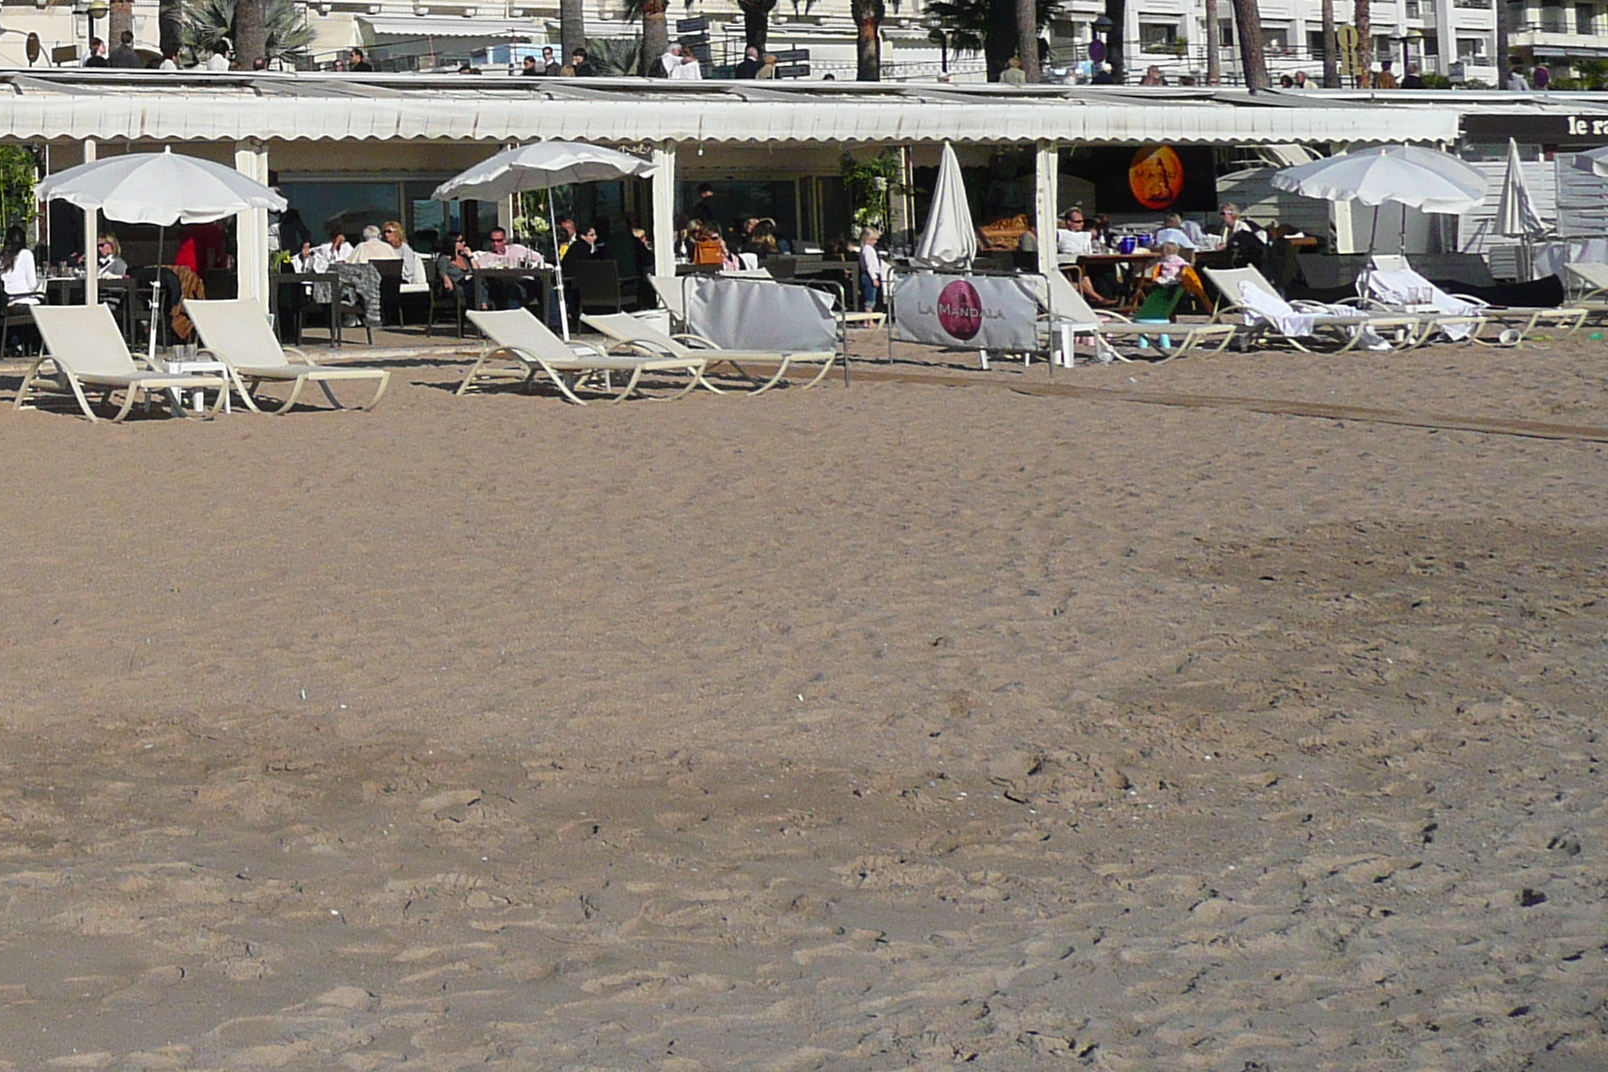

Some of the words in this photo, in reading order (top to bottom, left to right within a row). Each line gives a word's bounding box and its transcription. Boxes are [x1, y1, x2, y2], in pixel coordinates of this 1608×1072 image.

[1567, 116, 1587, 135] le
[918, 301, 935, 316] LA
[939, 303, 1006, 320] MANDALA
